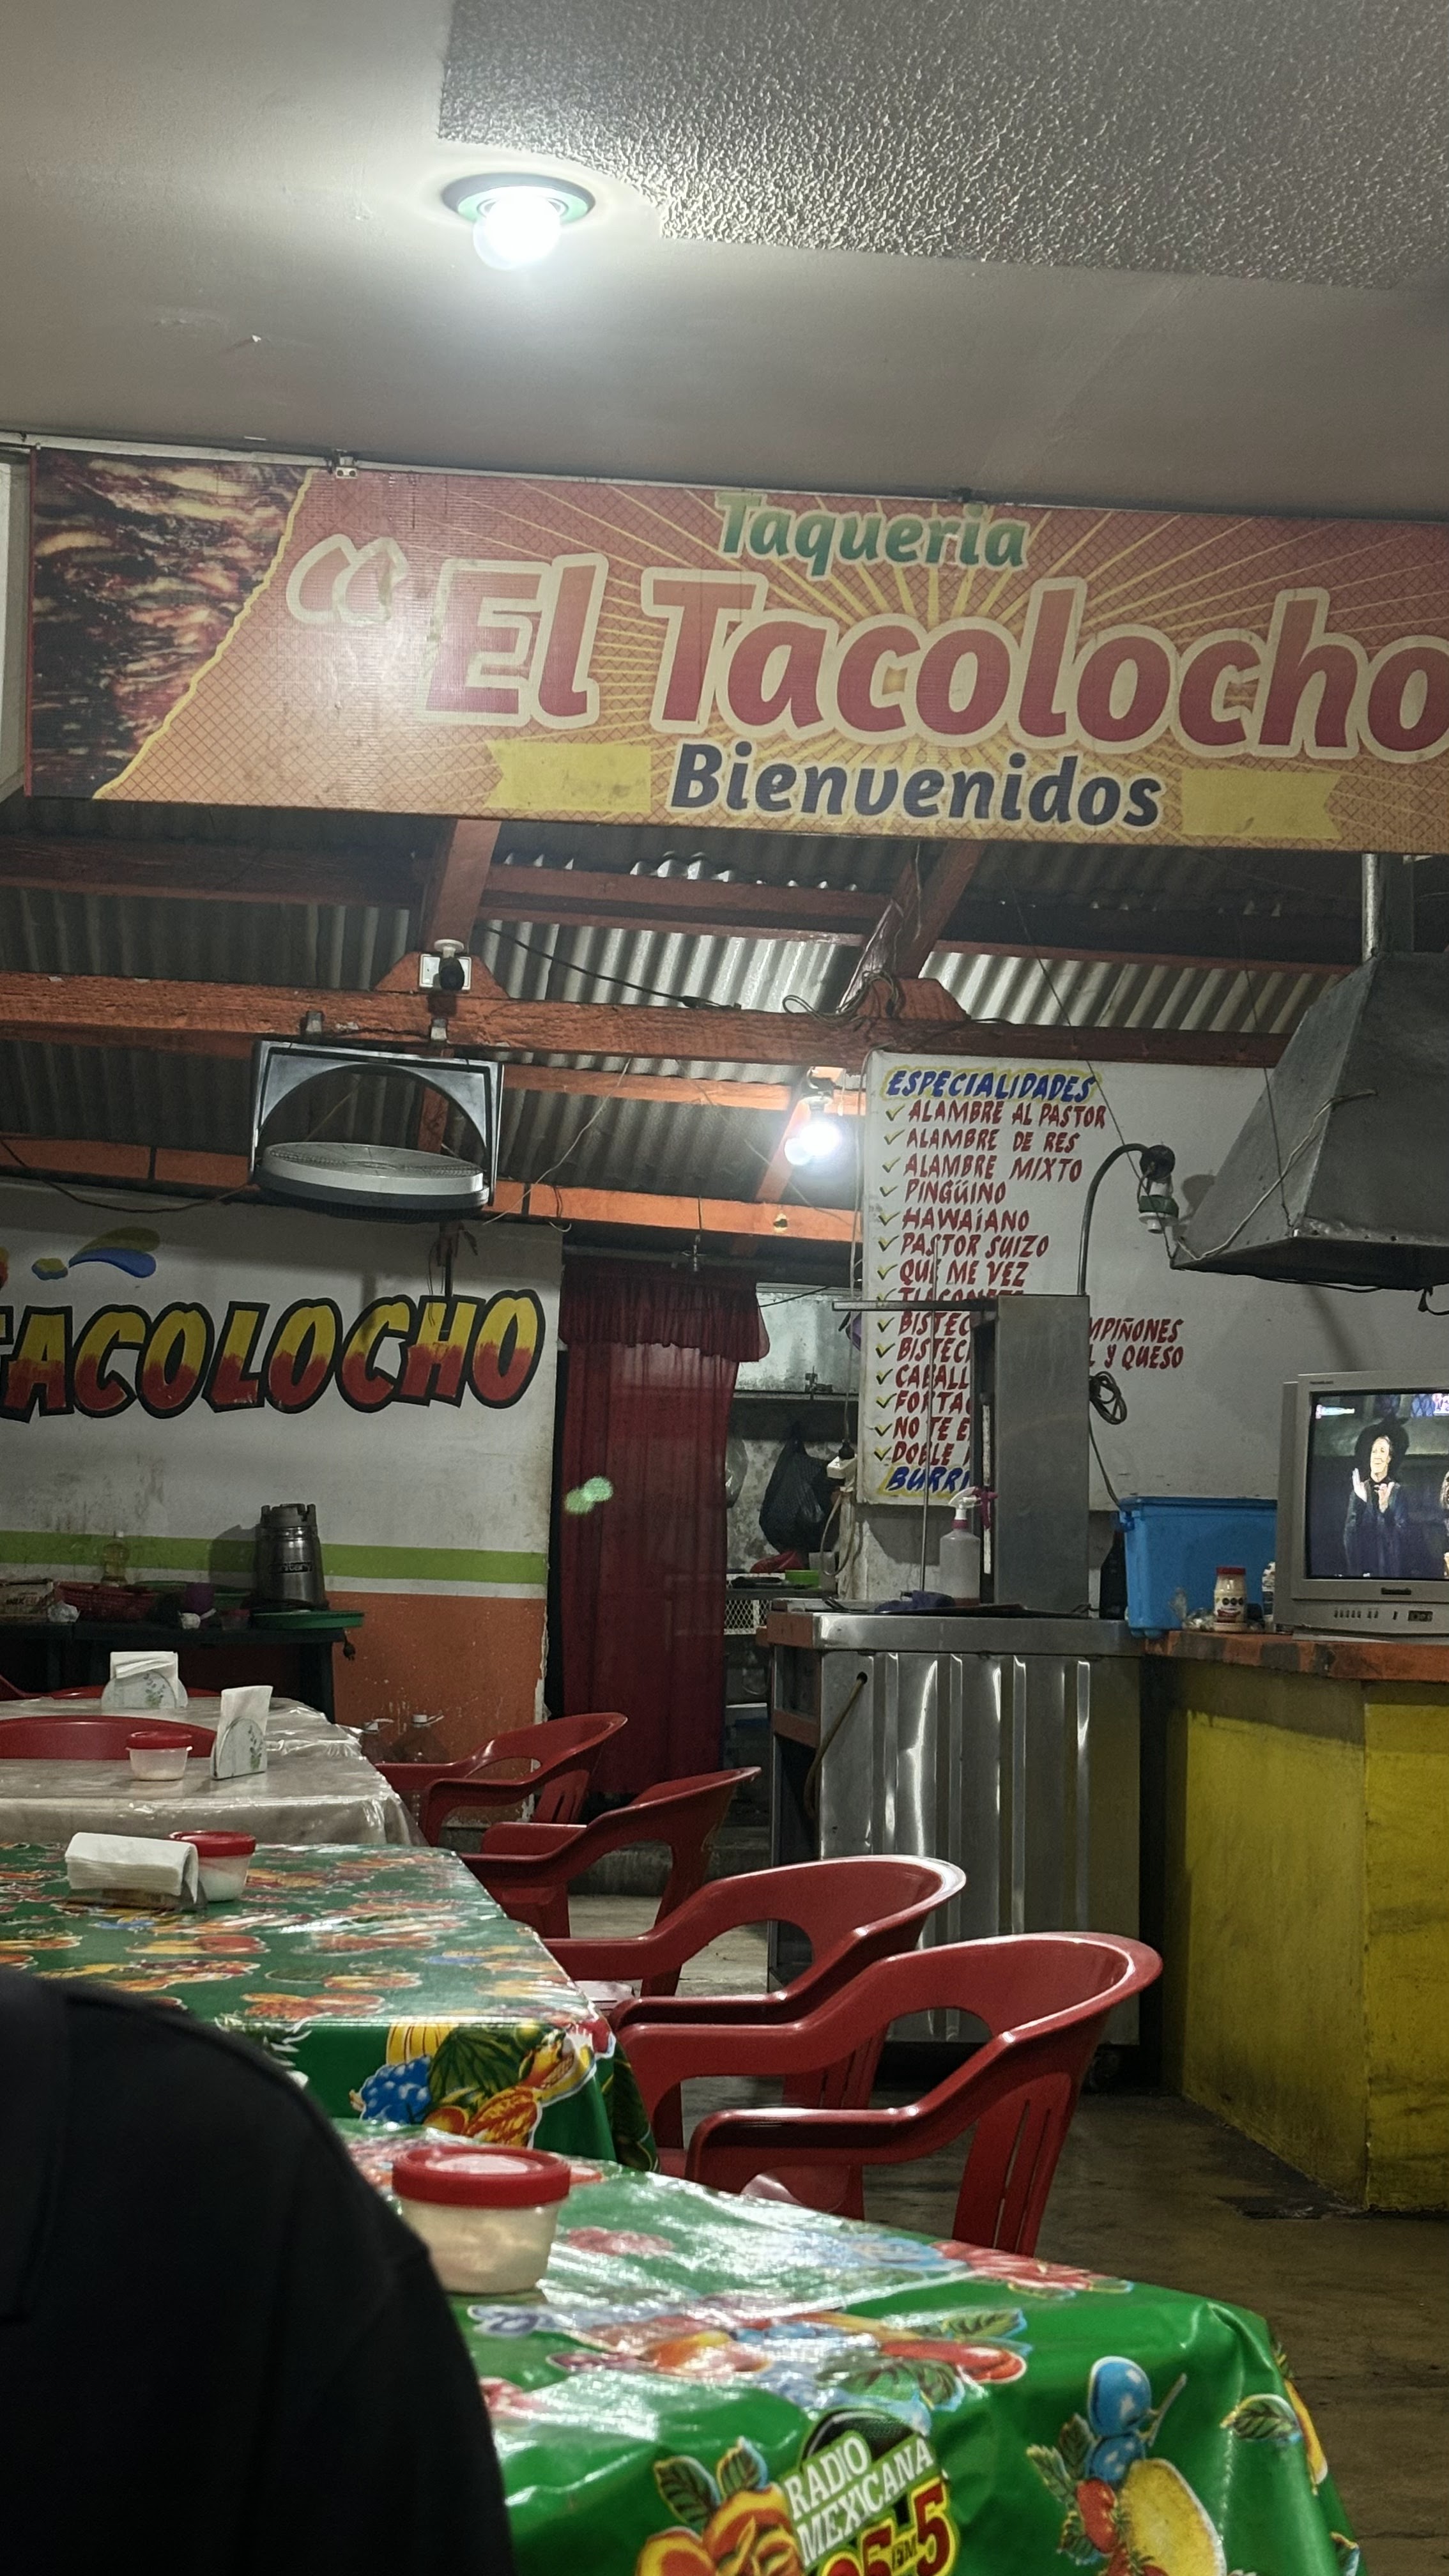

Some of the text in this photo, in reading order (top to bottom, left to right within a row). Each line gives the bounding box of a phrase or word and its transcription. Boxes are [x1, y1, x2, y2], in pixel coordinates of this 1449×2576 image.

[714, 491, 1031, 580] Taqueria
[641, 567, 1449, 762] Tacolocho
[670, 740, 1163, 831] Bienvenidos
[885, 1070, 1097, 1103] ESPECIALIDADES
[908, 1099, 1107, 1130] ALAMBRE AL PASTOR
[906, 1128, 1081, 1154] ALAMBRE DE RES
[903, 1153, 1083, 1183] ALAMBRE MIXTO
[904, 1179, 1007, 1205] PINGÜINO
[900, 1232, 1050, 1259] PASTOR SUIZO
[899, 1258, 1030, 1287] QUE ME VEZ
[0, 1289, 546, 1423] ACOLOCHO
[896, 1337, 971, 1363] BISTEC
[1103, 1343, 1117, 1369] Y
[1121, 1344, 1184, 1371] QUESO
[893, 1416, 920, 1440] NO
[930, 1416, 954, 1441] TE
[891, 1441, 955, 1466] DOBLE
[784, 2435, 869, 2521] RADIO
[796, 2437, 935, 2568] MEXICANA
